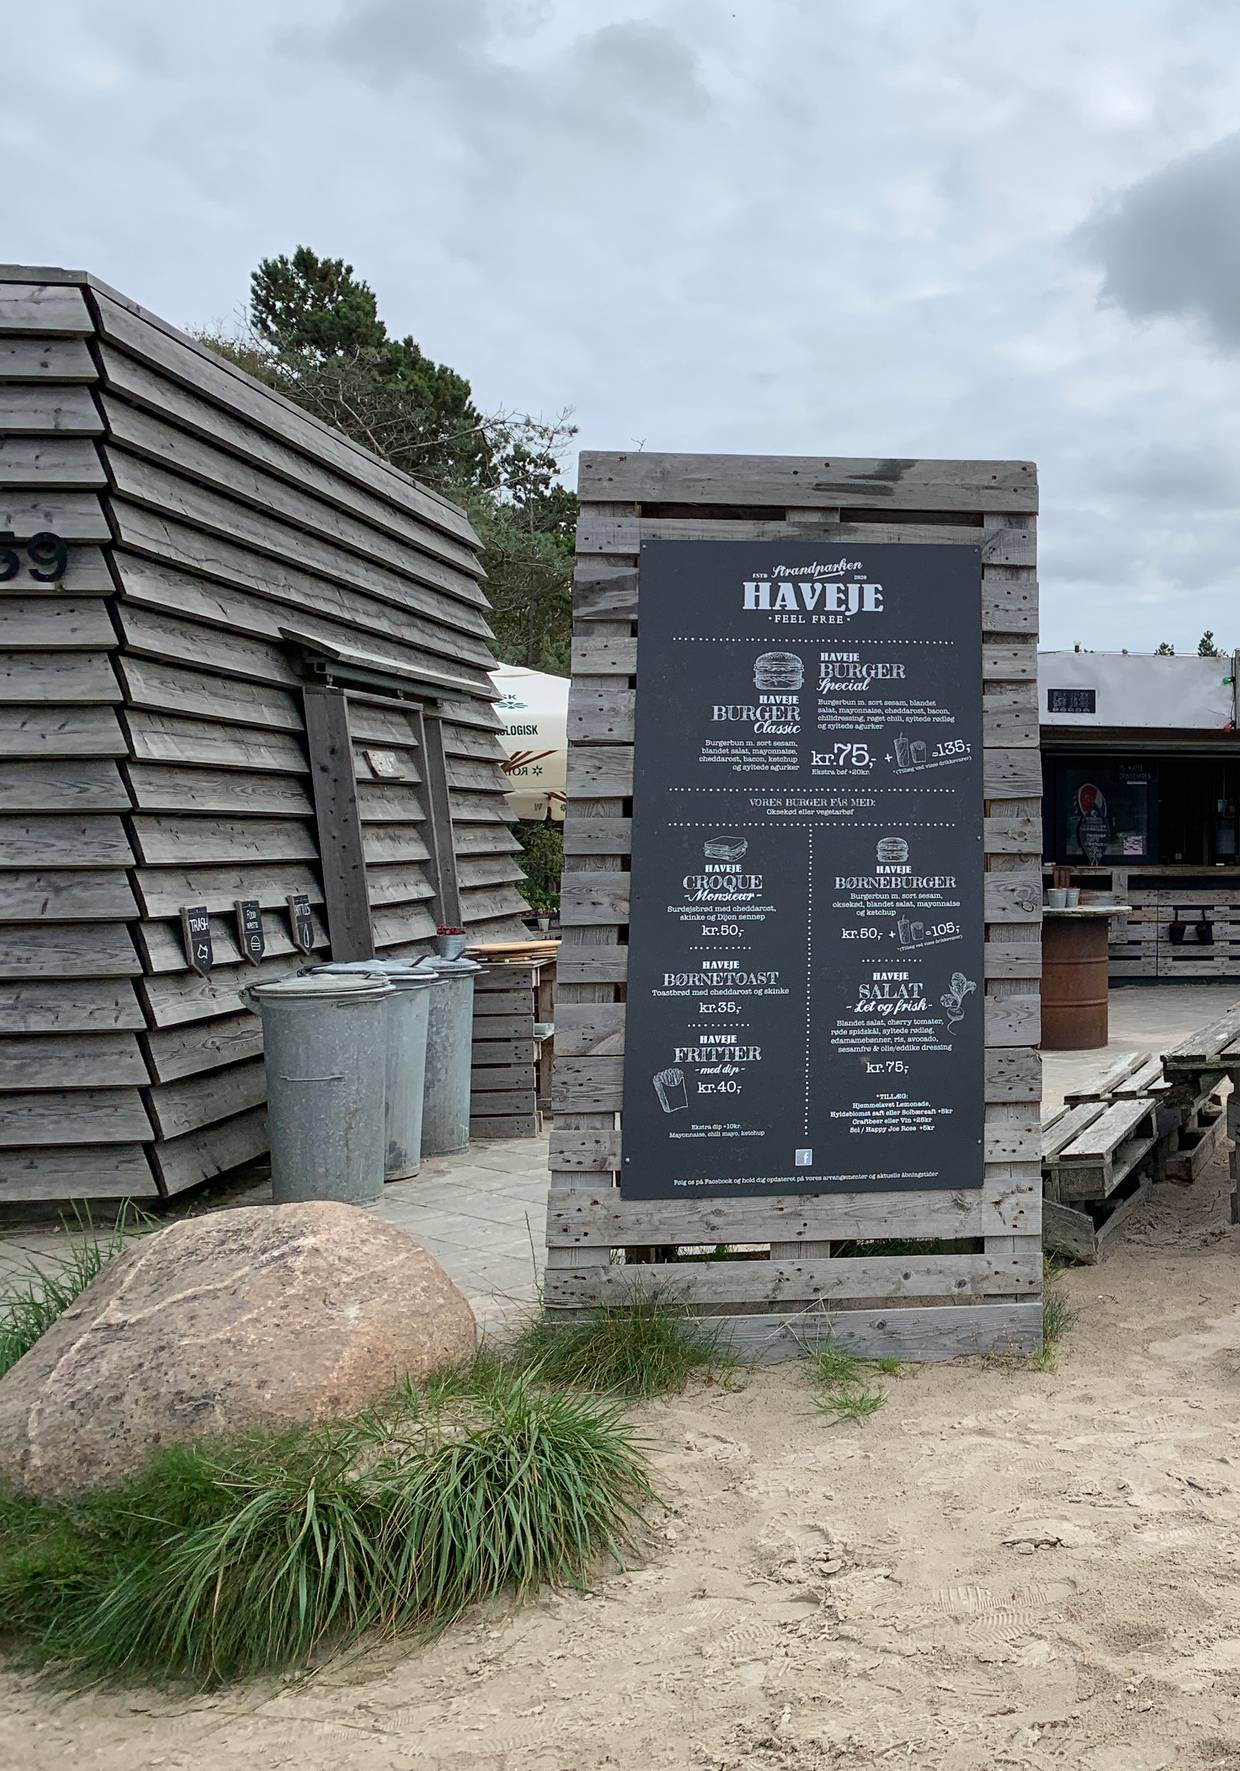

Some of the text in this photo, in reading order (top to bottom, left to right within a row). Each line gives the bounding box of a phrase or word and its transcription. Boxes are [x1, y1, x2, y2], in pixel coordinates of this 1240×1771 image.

[742, 582, 884, 615] HAVEJE
[774, 615, 844, 624] FEEL FREE
[820, 653, 860, 662] HAVEJE
[818, 664, 906, 679] BURGER
[817, 678, 871, 694] Special
[760, 695, 799, 705] HAVEJE
[712, 706, 800, 721] BURGER
[754, 721, 801, 734] Classic
[811, 744, 876, 768] kr.75,-
[705, 864, 742, 873] HAVEJE
[876, 866, 912, 874] HAVEJE
[682, 875, 763, 892] CROQUE
[834, 876, 956, 889] BØRNEBURGER
[190, 917, 208, 932] TRASH
[702, 961, 740, 970] HAVEJE
[662, 972, 779, 986] BØRNETOAST
[873, 972, 910, 981] HAVEJE
[858, 982, 923, 1000] SALAT
[854, 998, 928, 1016] Let og frisk
[700, 1035, 737, 1044] HAVEJE
[673, 1046, 762, 1063] FRITTER
